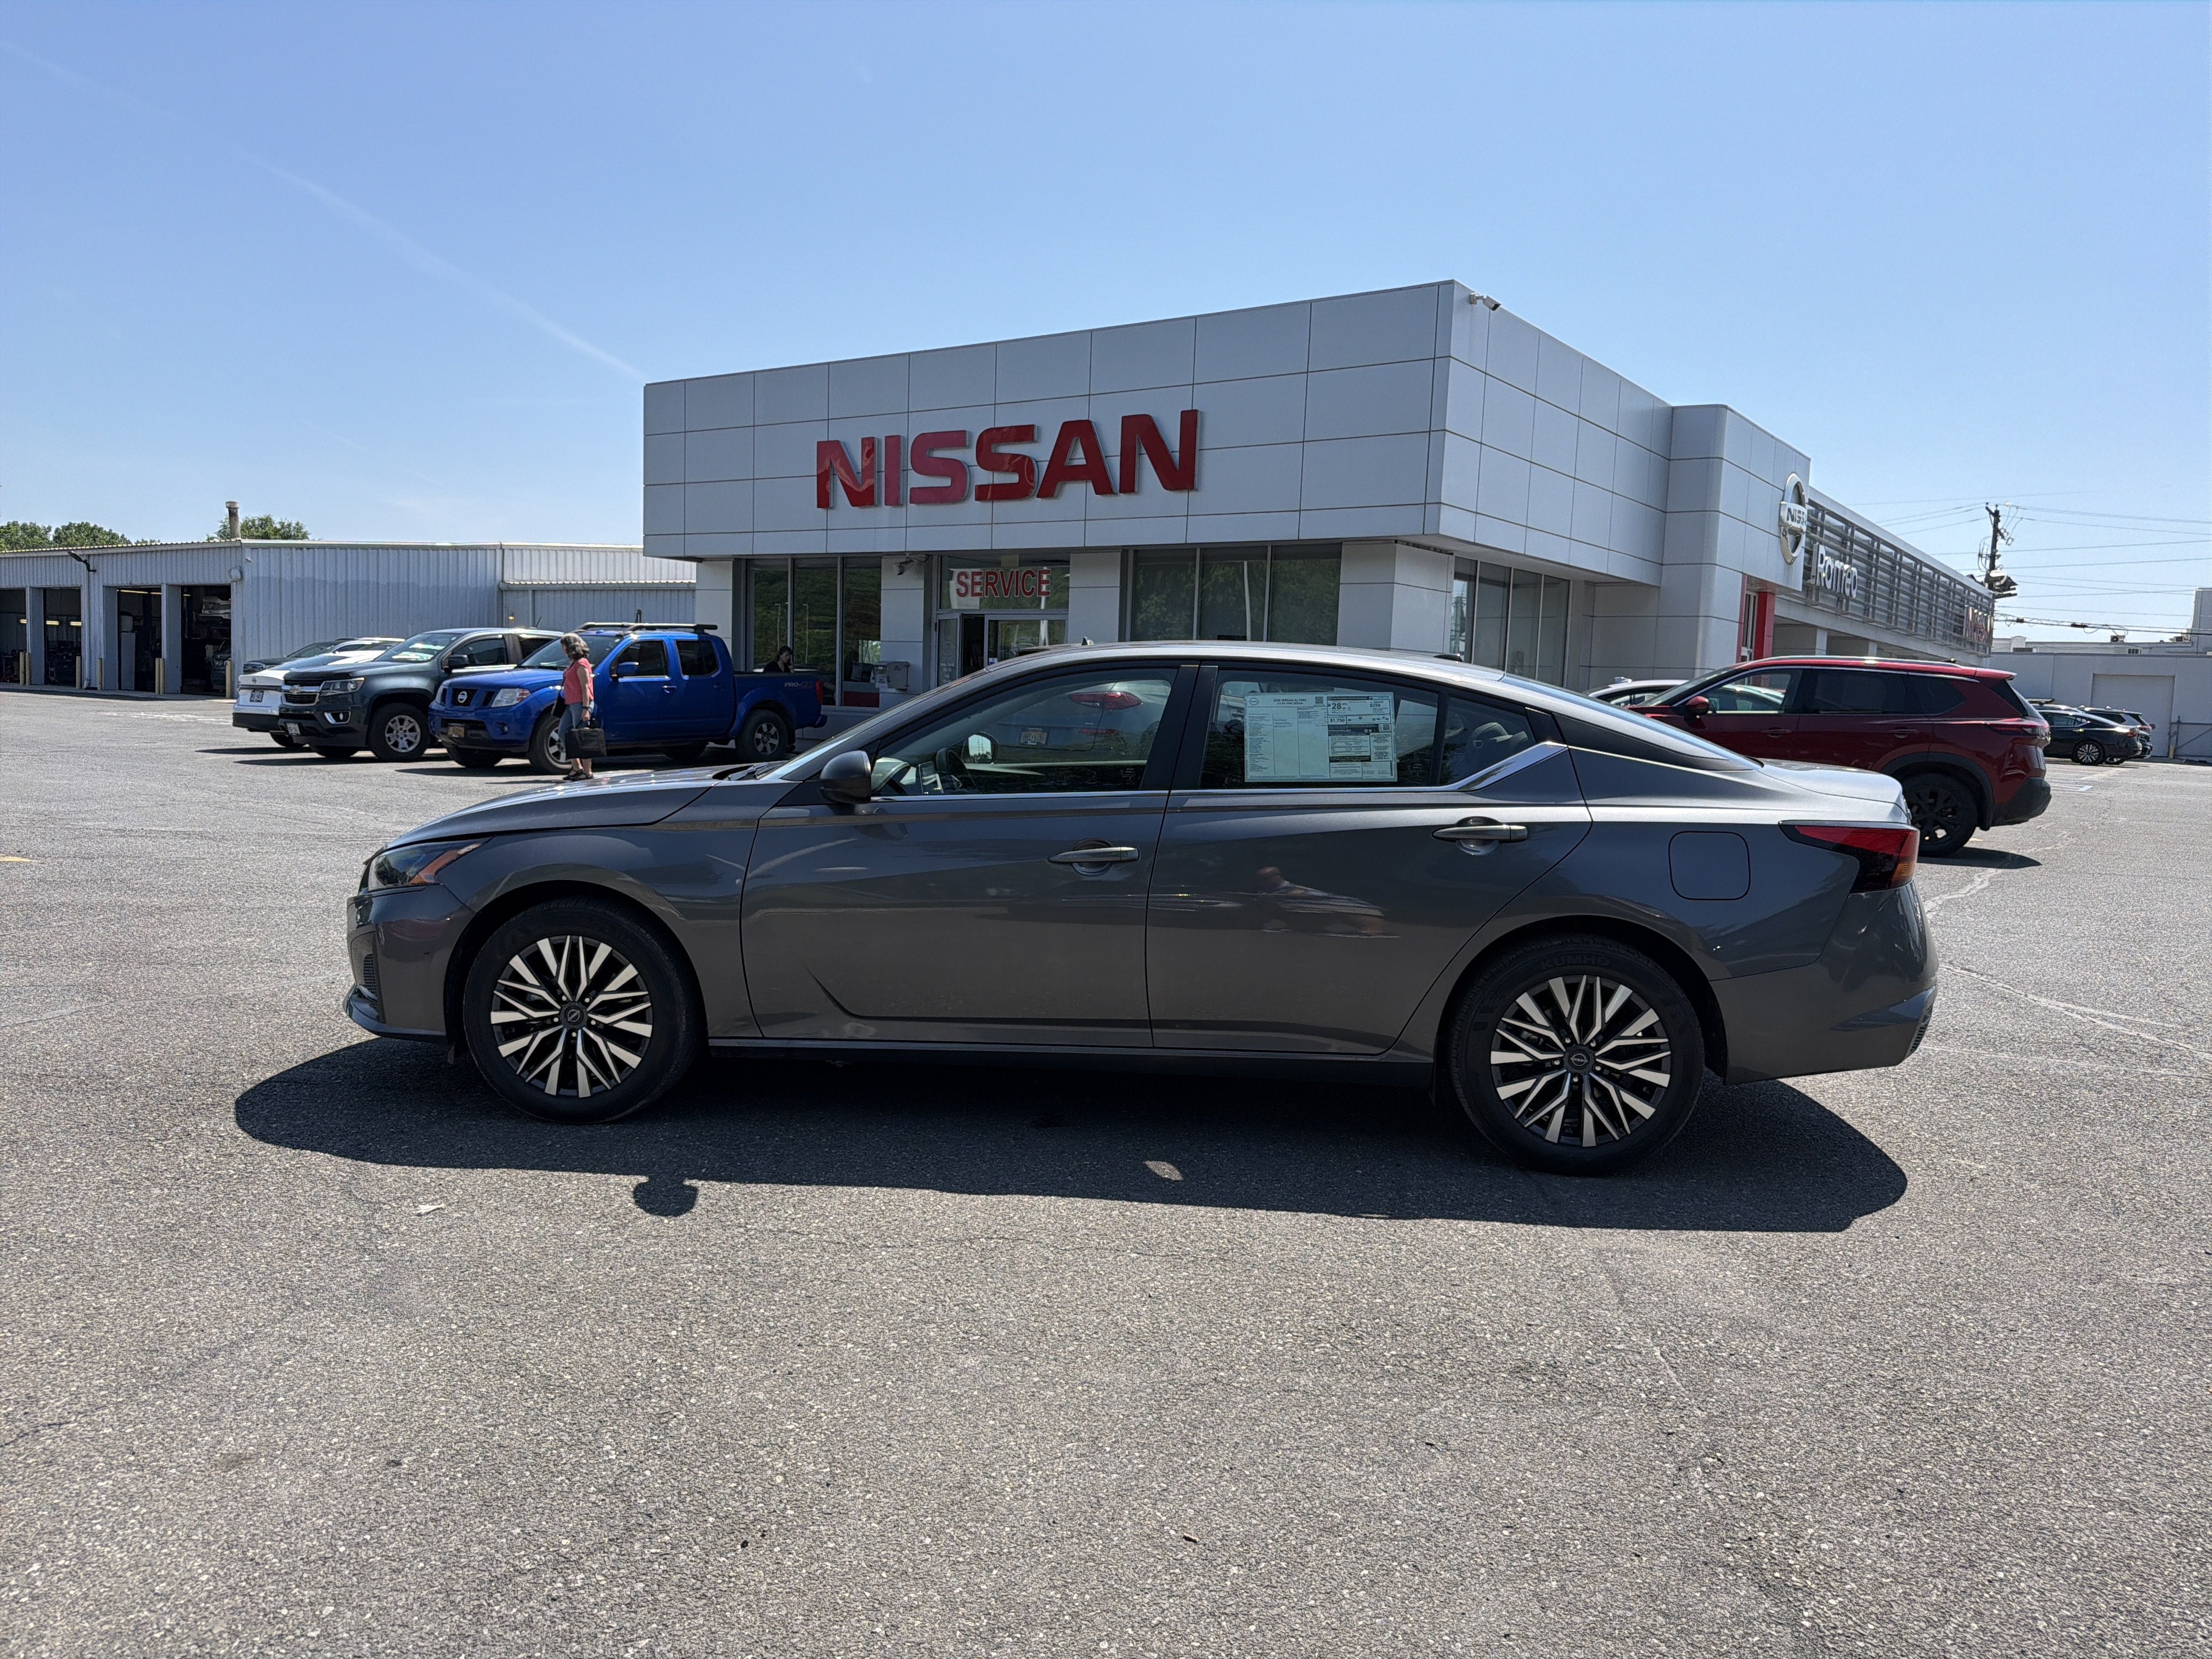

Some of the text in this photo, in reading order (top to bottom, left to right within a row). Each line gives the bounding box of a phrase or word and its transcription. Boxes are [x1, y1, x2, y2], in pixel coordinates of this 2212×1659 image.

[816, 409, 1202, 509] NISSAN
[956, 569, 1052, 598] SERVICE
[1812, 542, 1858, 599] Romeo
